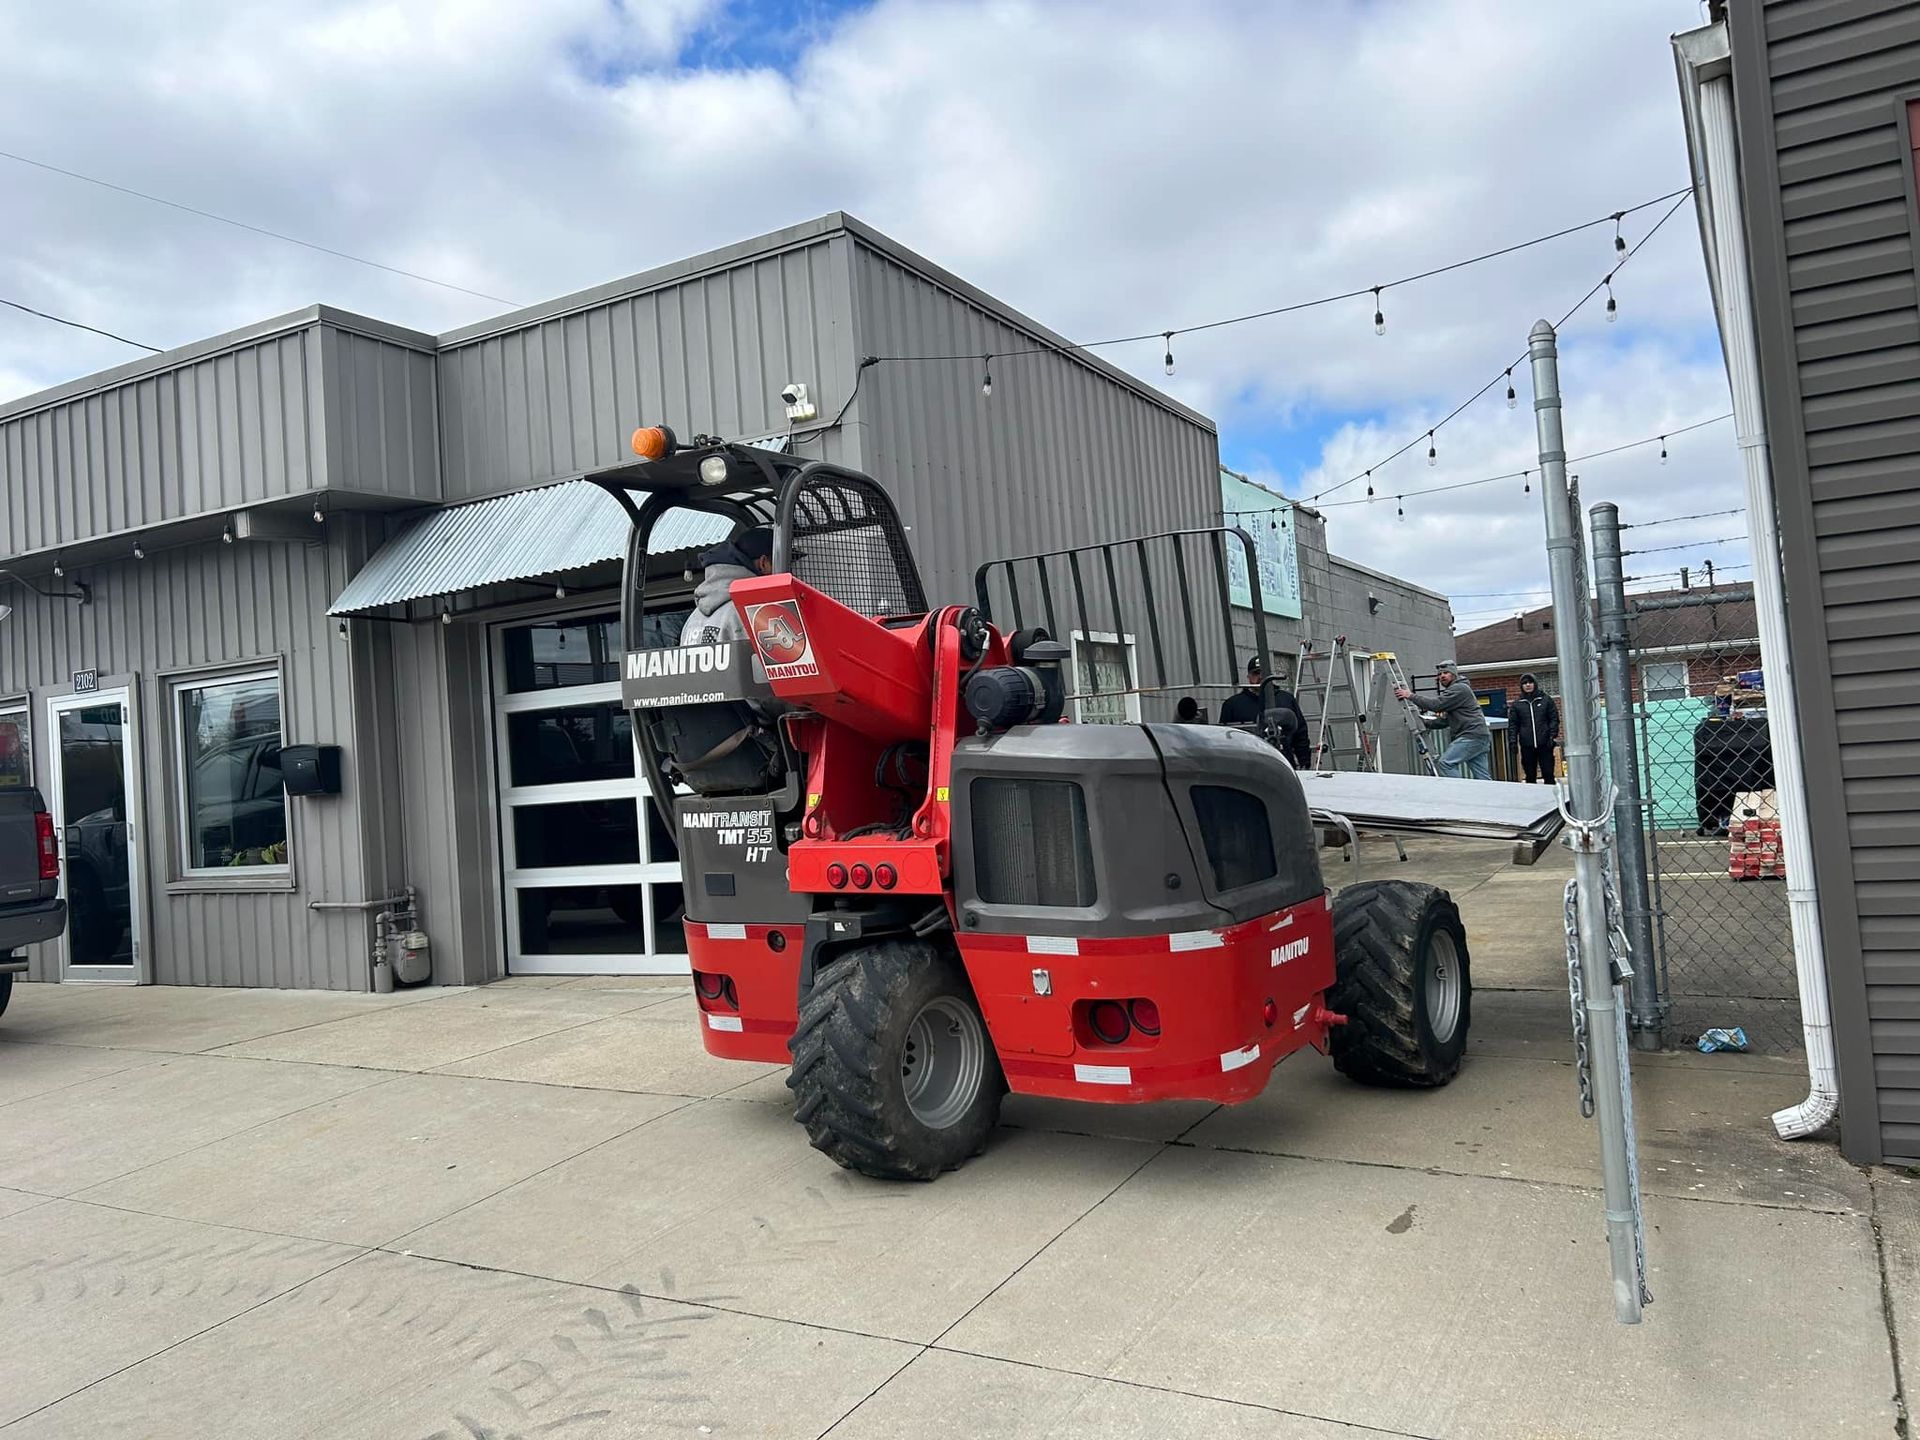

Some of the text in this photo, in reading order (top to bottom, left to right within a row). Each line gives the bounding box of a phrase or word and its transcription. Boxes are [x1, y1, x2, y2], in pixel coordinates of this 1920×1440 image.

[627, 643, 731, 680] MANITOU
[766, 663, 817, 679] MANITOU
[76, 673, 94, 690] 2102
[633, 691, 725, 707] www.manitou.com
[683, 810, 771, 828] MANITRANSIT
[717, 828, 772, 845] TMT 55
[746, 846, 772, 863] HT
[1271, 936, 1309, 968] MANITOU
